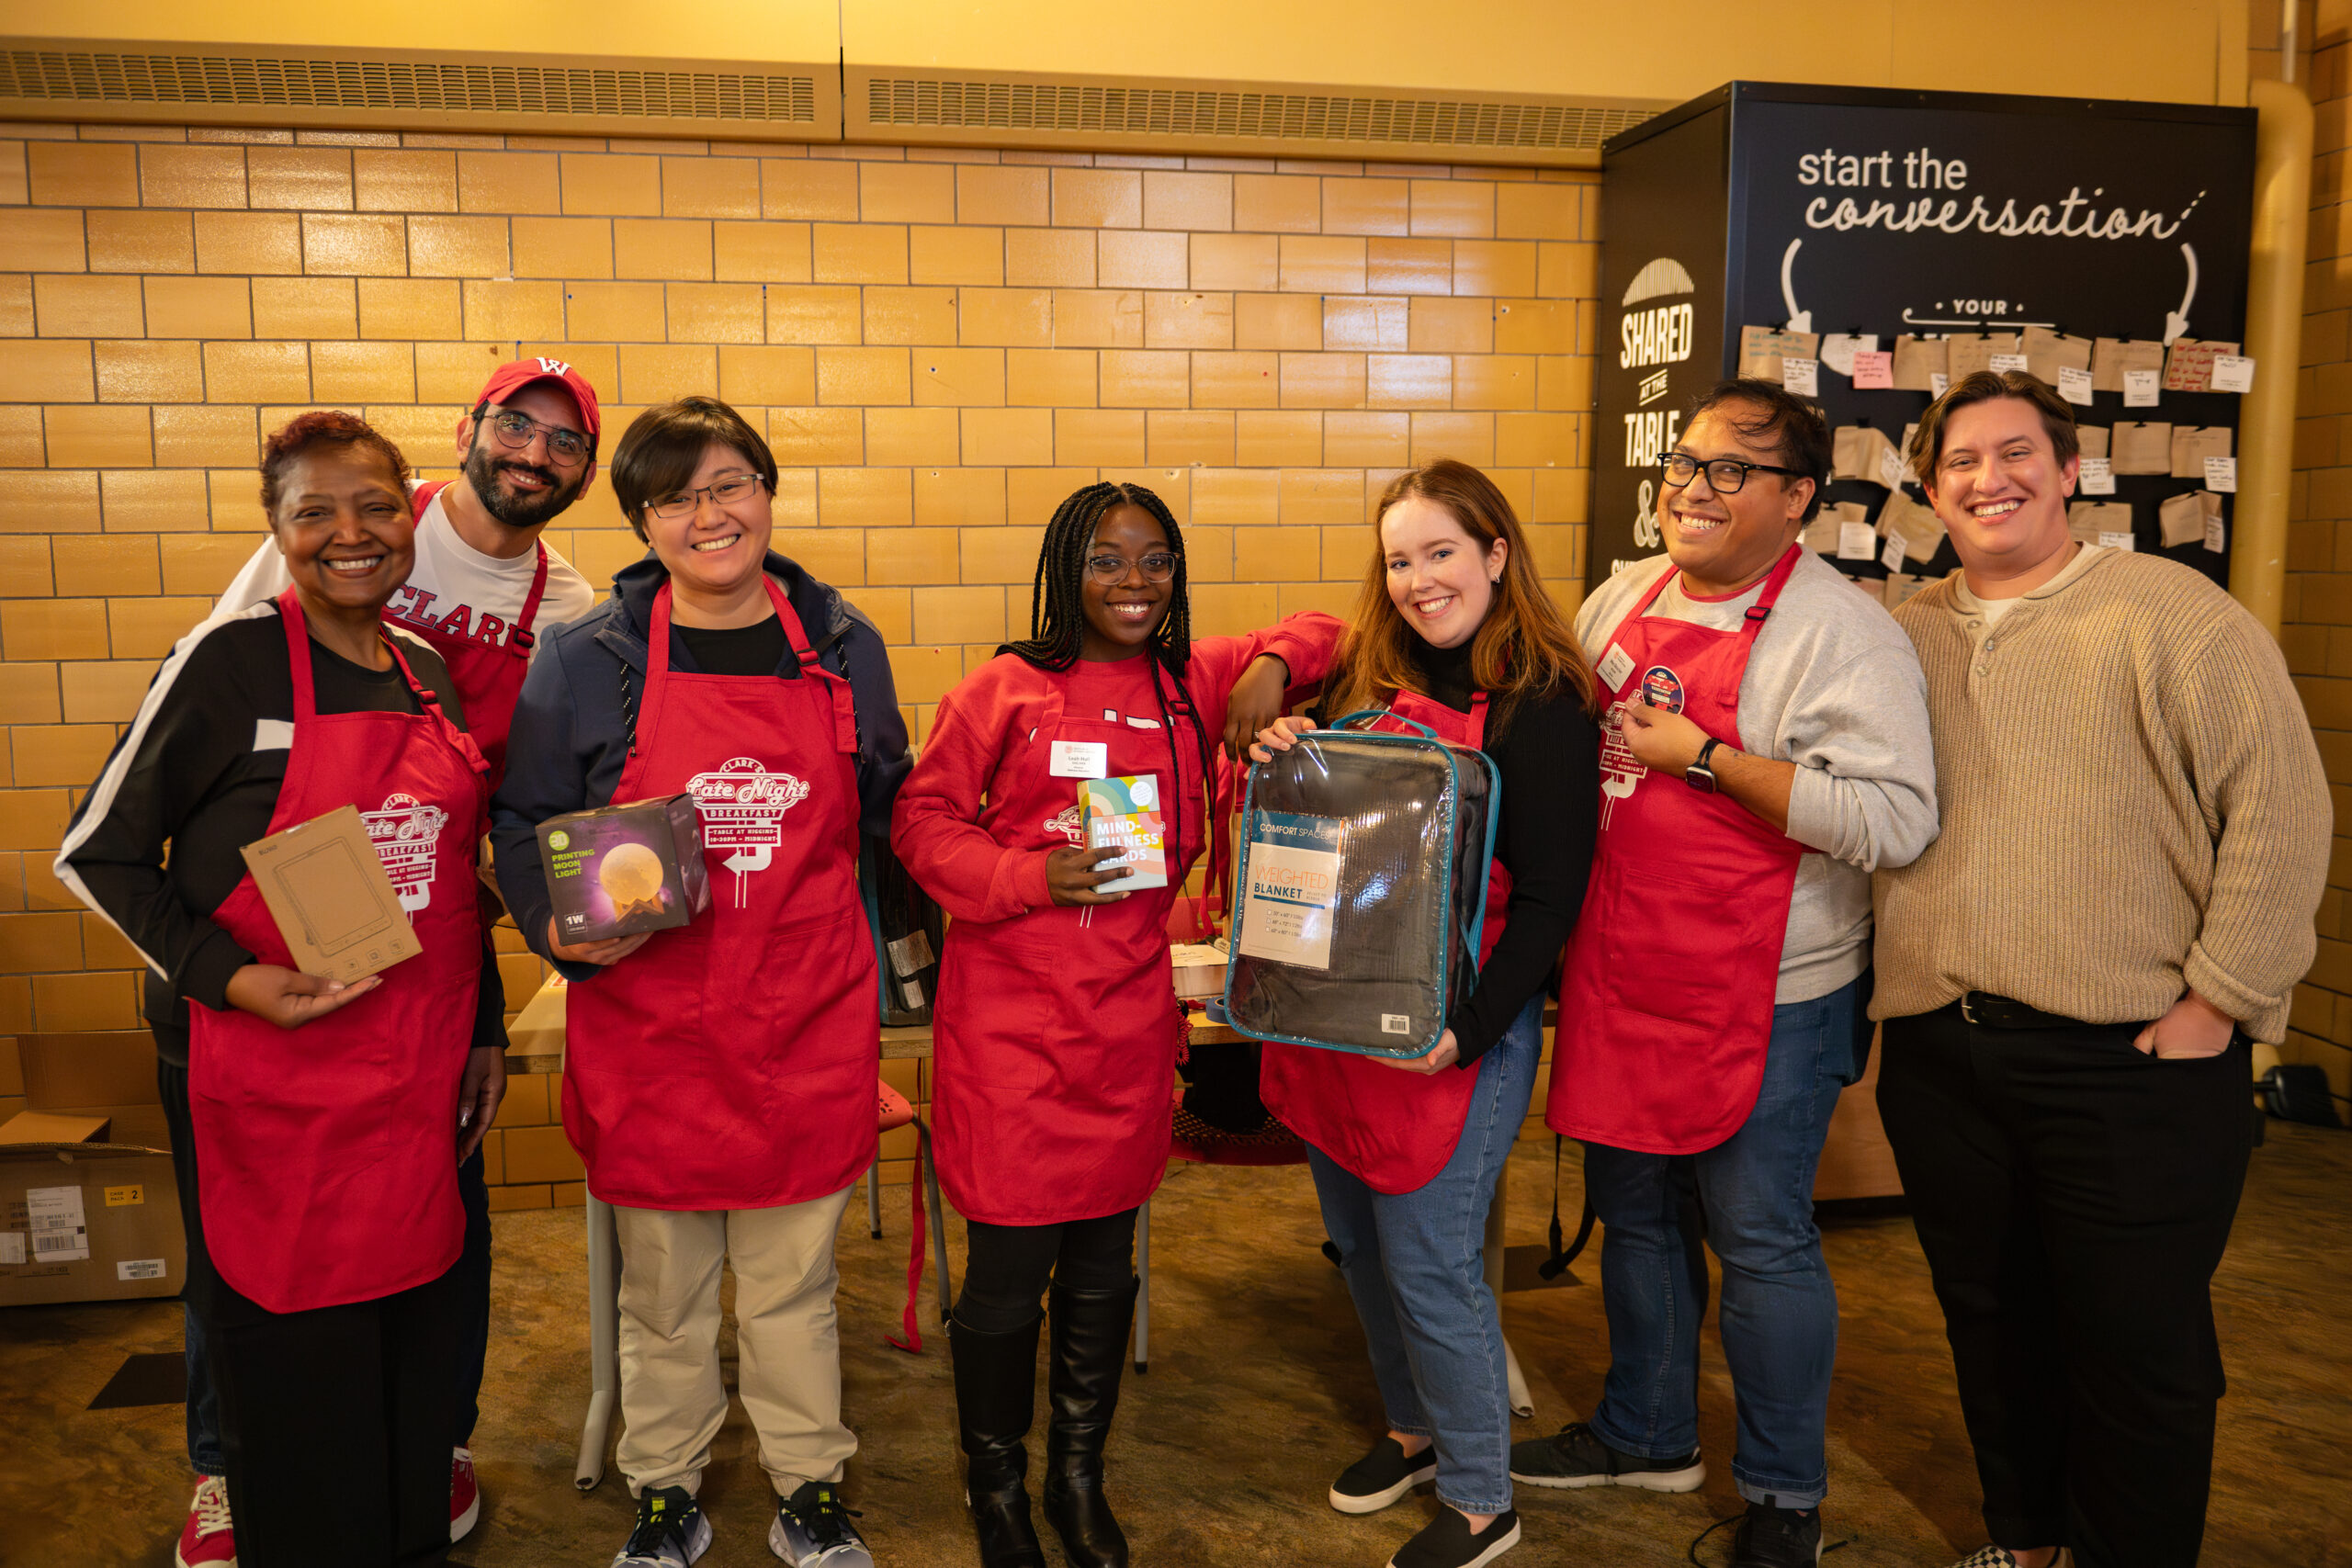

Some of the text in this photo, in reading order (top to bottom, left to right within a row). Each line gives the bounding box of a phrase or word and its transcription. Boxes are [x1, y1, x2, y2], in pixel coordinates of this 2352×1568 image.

[1797, 147, 1968, 190] start the
[1804, 186, 2181, 241] conversation
[1952, 299, 2008, 316] YOUR
[1620, 302, 1694, 369] SHARED
[1639, 373, 1668, 401] AT THE
[1623, 410, 1680, 468] TABLE
[1633, 479, 1660, 549] &
[722, 759, 764, 773] CLARK'S
[686, 776, 810, 807] Late Night
[710, 809, 778, 818] BREAKFAST
[394, 808, 448, 841] Night
[1096, 820, 1142, 836] MIND-
[1260, 823, 1330, 840] COMFORT SPACES
[550, 833, 568, 848] 3D
[1097, 832, 1159, 848] FULNESS
[379, 842, 434, 858] REAKFAST
[551, 849, 595, 863] PRINTING
[553, 860, 581, 871] MOON
[554, 868, 582, 879] LIGHT
[1255, 863, 1329, 890] WEIGHTED
[1253, 882, 1303, 899] BLANKET
[565, 914, 584, 925] 1W
[131, 1190, 139, 1200] 2
